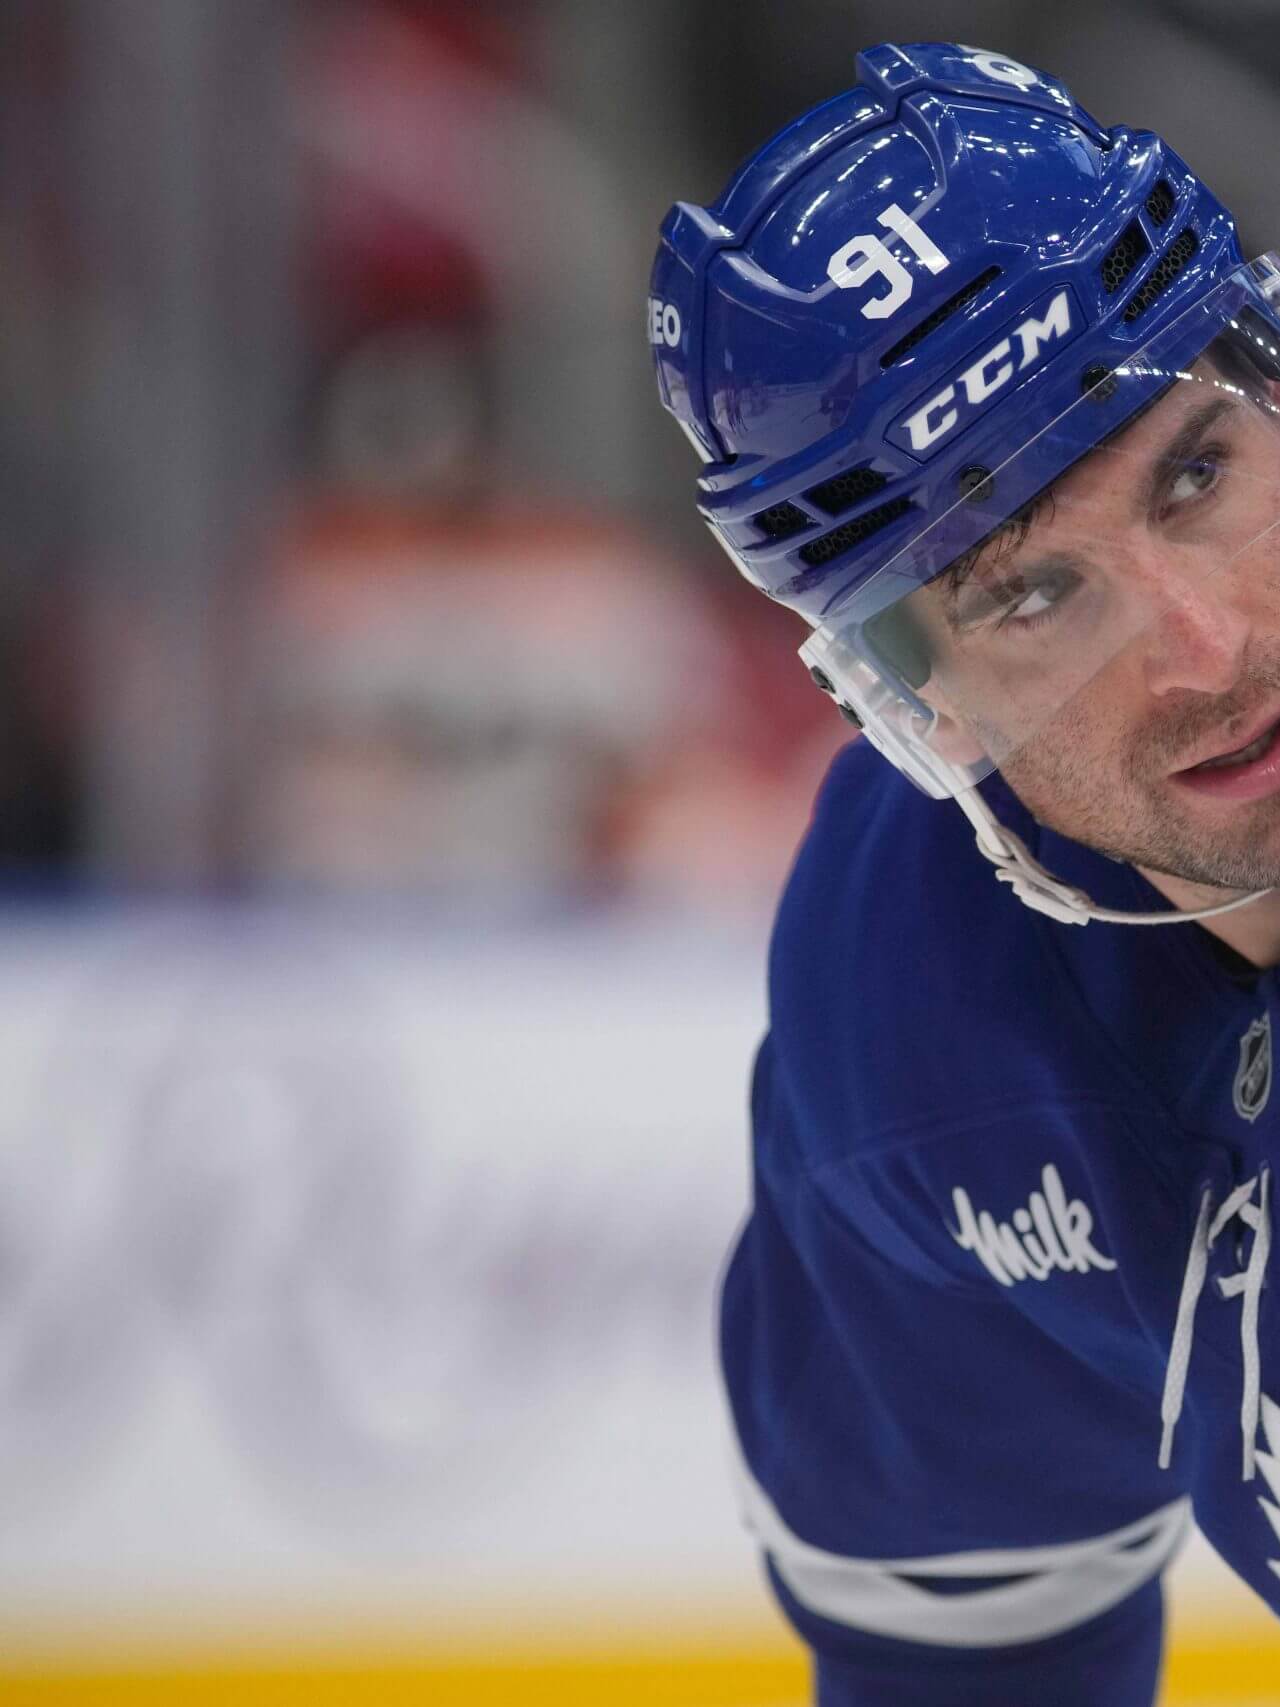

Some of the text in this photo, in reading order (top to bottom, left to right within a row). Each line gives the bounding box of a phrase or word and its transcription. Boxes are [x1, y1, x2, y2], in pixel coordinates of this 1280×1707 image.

[826, 203, 951, 320] 91
[648, 297, 681, 348] EO
[901, 290, 1071, 450] CCM
